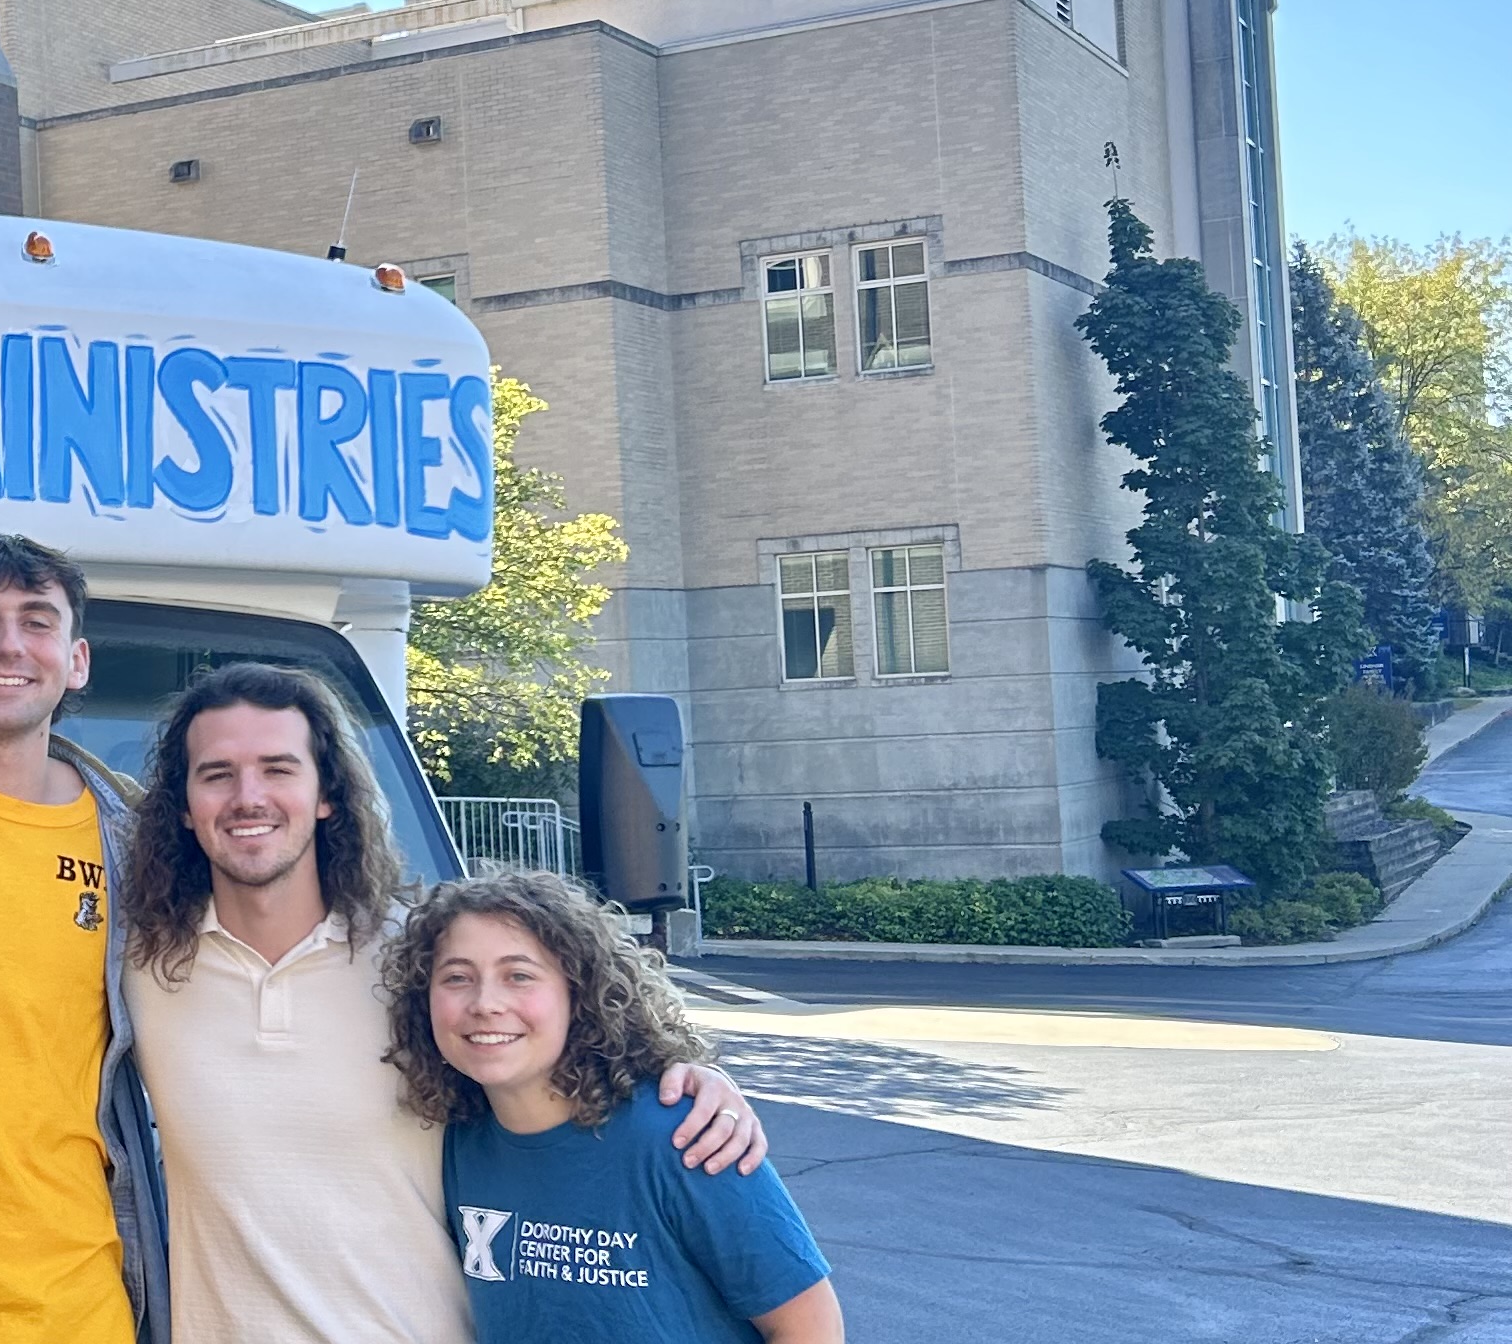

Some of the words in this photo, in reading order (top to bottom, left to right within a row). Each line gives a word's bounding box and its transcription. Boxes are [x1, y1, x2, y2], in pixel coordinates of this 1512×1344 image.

[55, 854, 108, 892] BW
[520, 1220, 594, 1246] DOROTHY
[597, 1230, 638, 1250] DAY
[518, 1239, 571, 1263] CENTER
[574, 1247, 611, 1267] FOR
[518, 1259, 558, 1280] FAITH
[560, 1265, 573, 1282] &
[576, 1266, 649, 1288] JUSTICE
